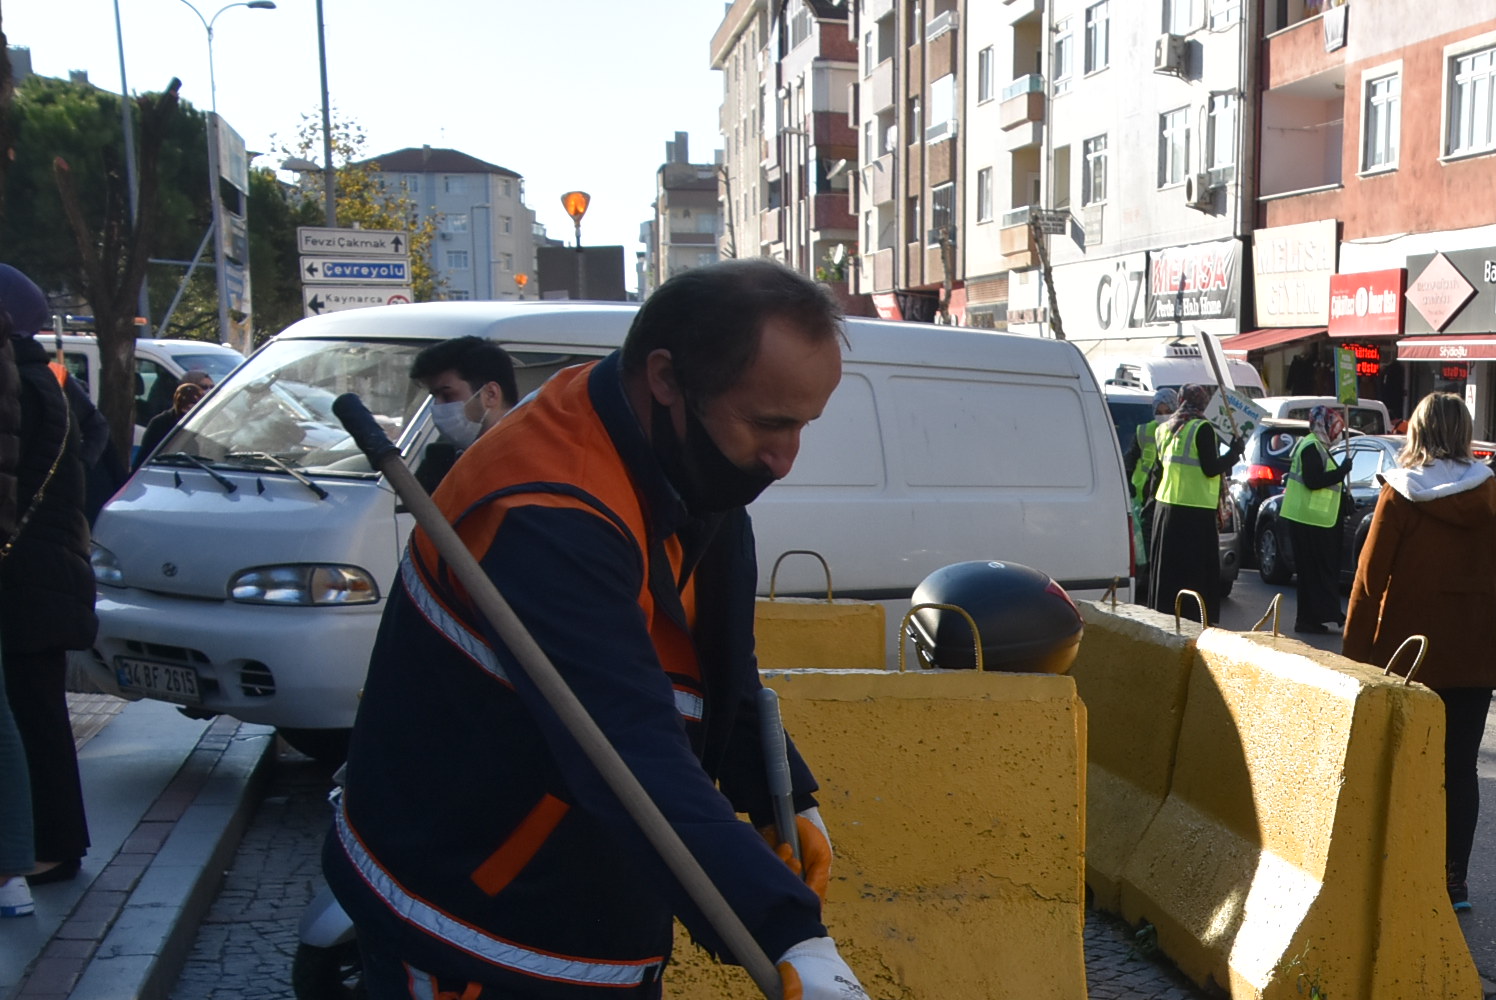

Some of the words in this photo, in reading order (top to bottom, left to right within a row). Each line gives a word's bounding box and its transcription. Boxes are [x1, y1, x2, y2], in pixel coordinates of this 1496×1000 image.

[304, 236, 336, 246] Fevzi
[337, 237, 386, 248] Çakmak
[323, 263, 404, 278] Çevreyolu
[325, 293, 383, 304] Kaynarca
[124, 662, 141, 686] 34
[164, 668, 195, 694] 2615
